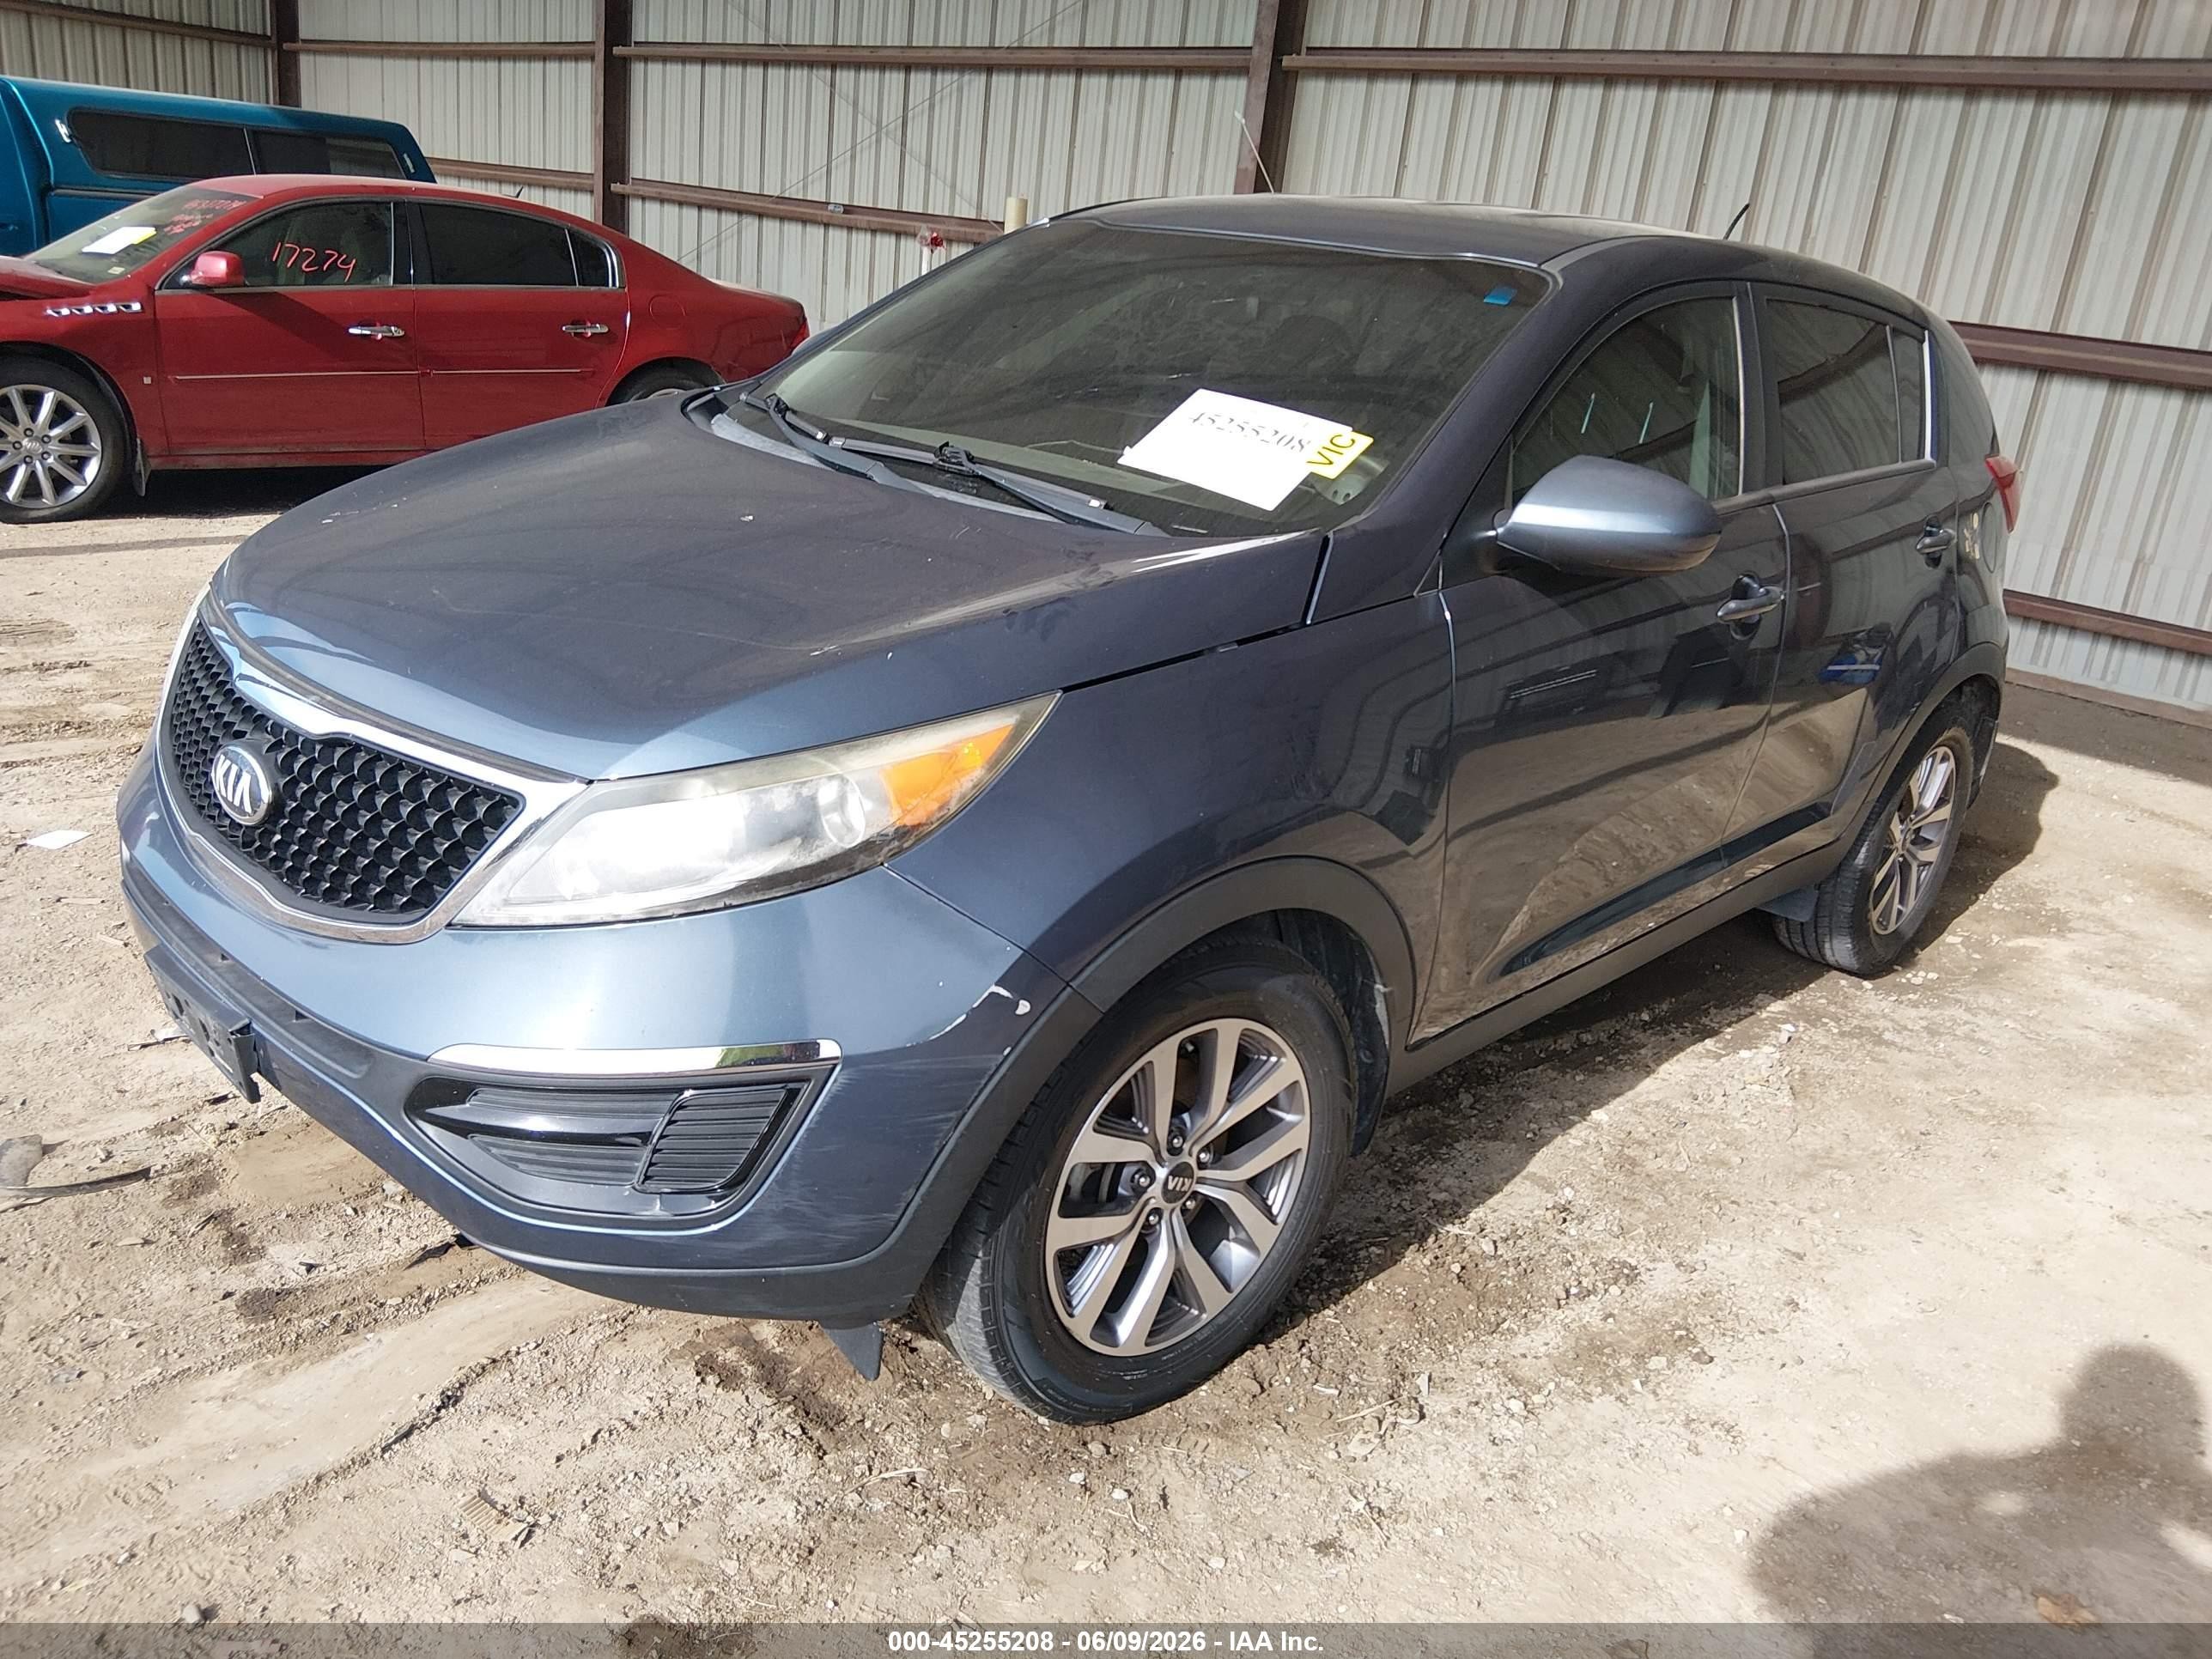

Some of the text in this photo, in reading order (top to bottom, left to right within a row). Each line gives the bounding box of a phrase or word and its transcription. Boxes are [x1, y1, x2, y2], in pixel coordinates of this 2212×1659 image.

[272, 241, 356, 283] 17274
[1306, 433, 1357, 468] VIC
[215, 754, 252, 814] KIA
